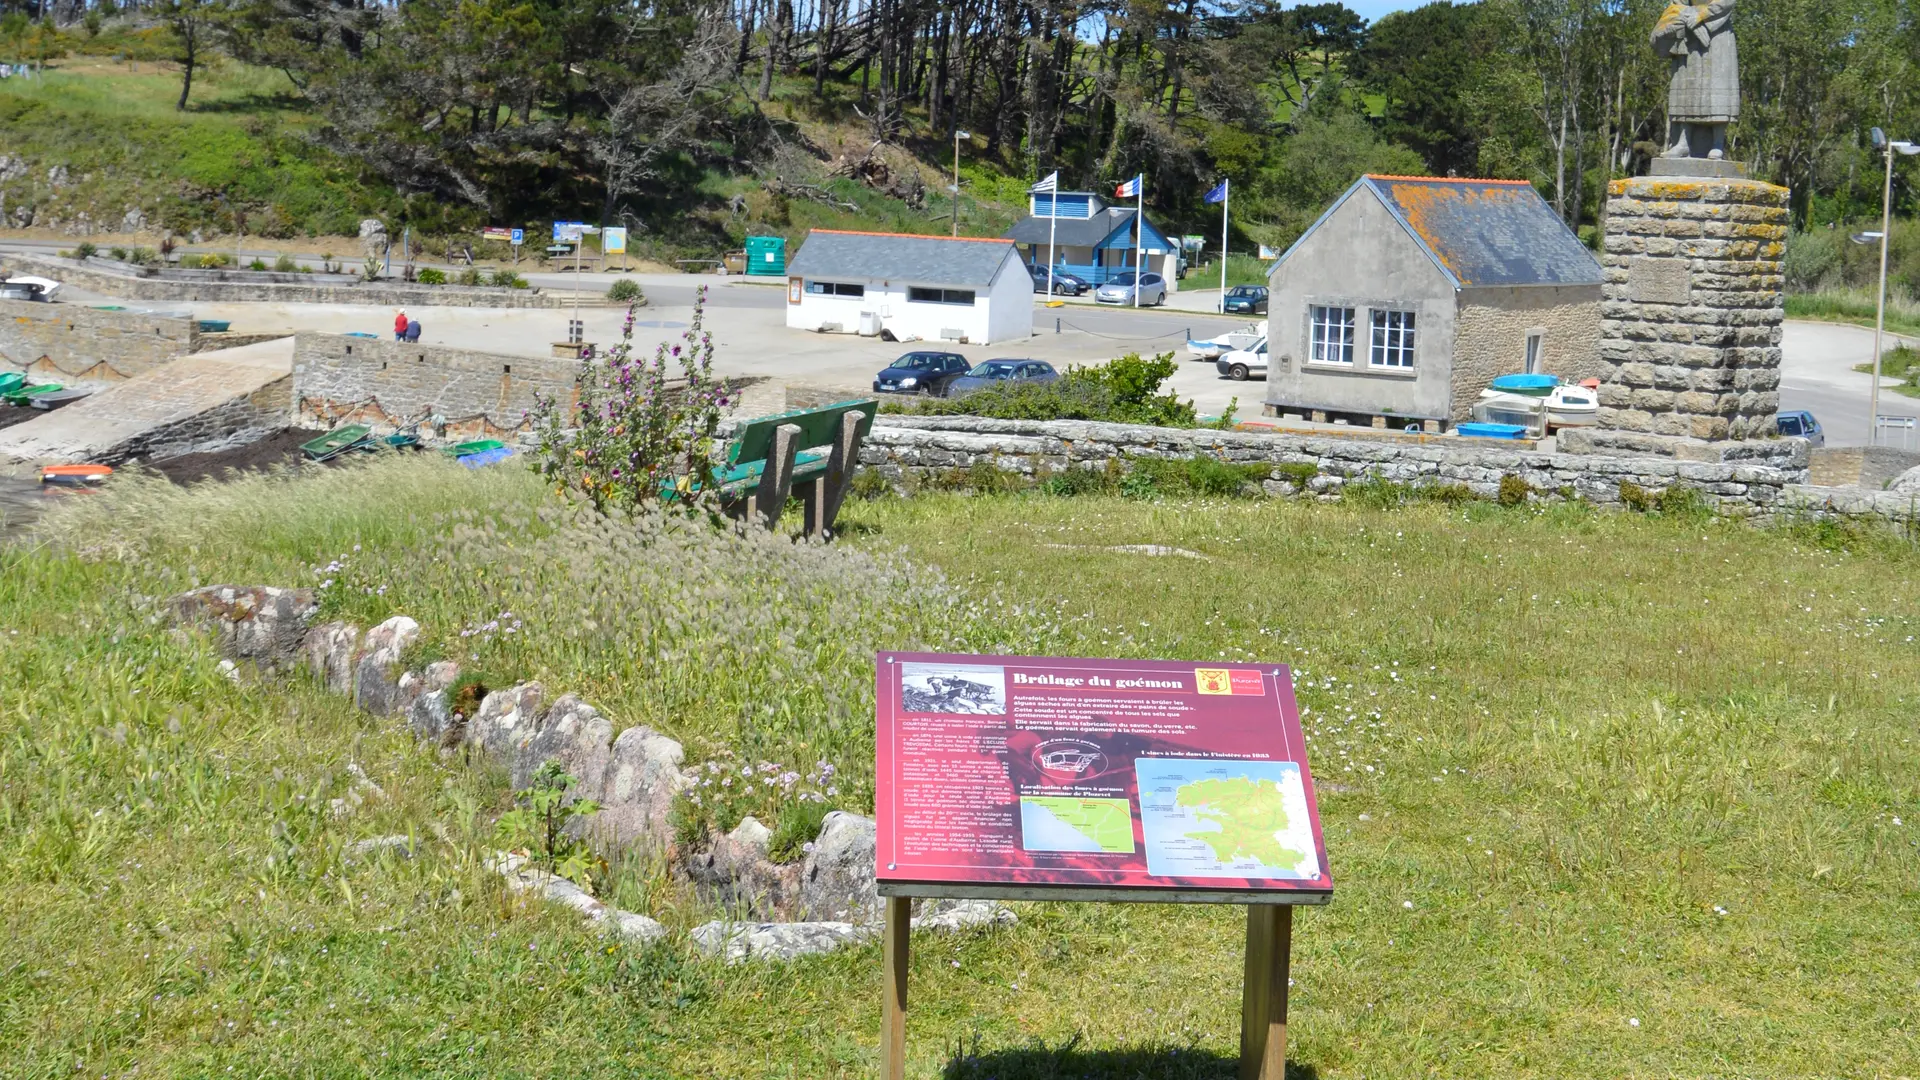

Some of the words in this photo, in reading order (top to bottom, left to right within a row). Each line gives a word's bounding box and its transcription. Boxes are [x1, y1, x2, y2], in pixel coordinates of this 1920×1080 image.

[1013, 673, 1084, 688] Brûlage
[1088, 675, 1111, 686] du
[1116, 676, 1183, 691] goémon
